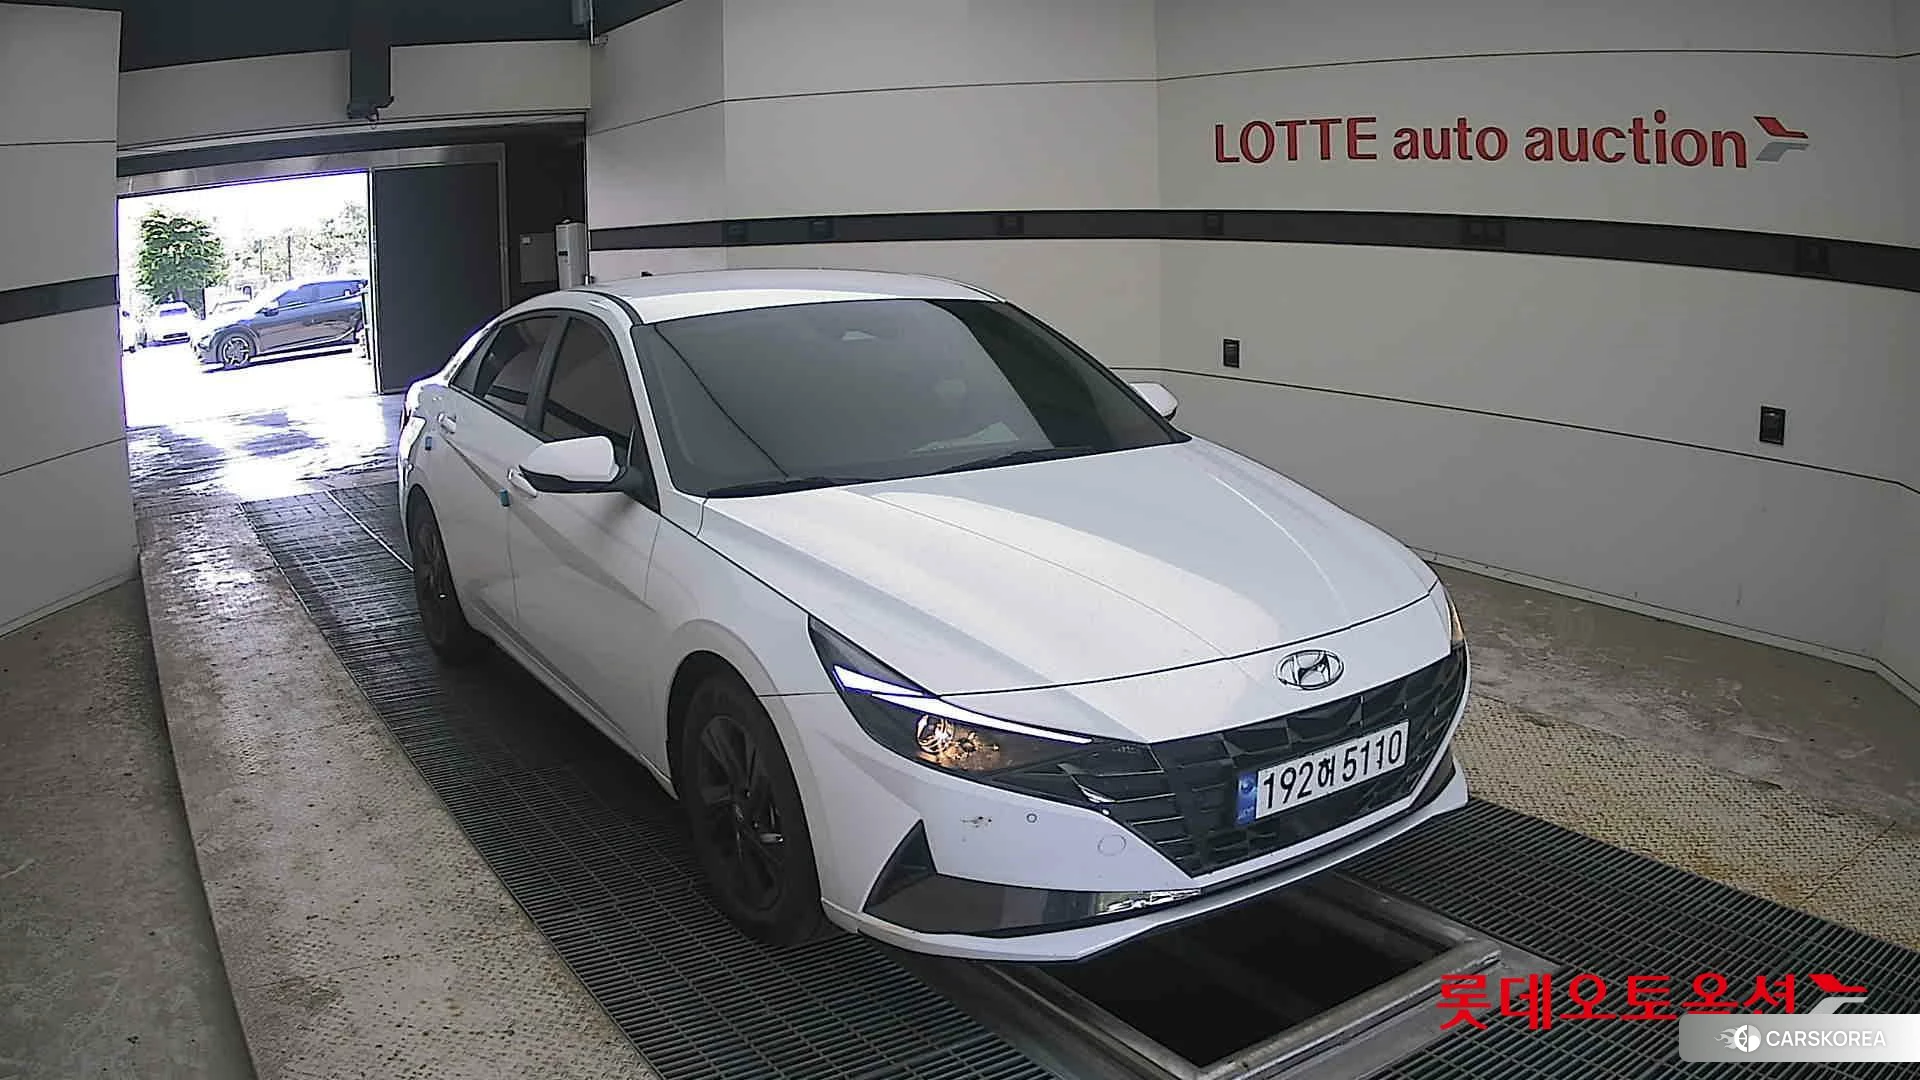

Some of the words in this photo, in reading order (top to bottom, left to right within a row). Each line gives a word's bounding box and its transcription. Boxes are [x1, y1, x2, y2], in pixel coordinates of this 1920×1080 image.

[1214, 116, 1377, 163] LOTTE
[1393, 117, 1508, 161] auto
[1524, 109, 1747, 169] auction
[1263, 755, 1335, 809] 192허
[1342, 730, 1402, 782] 5110
